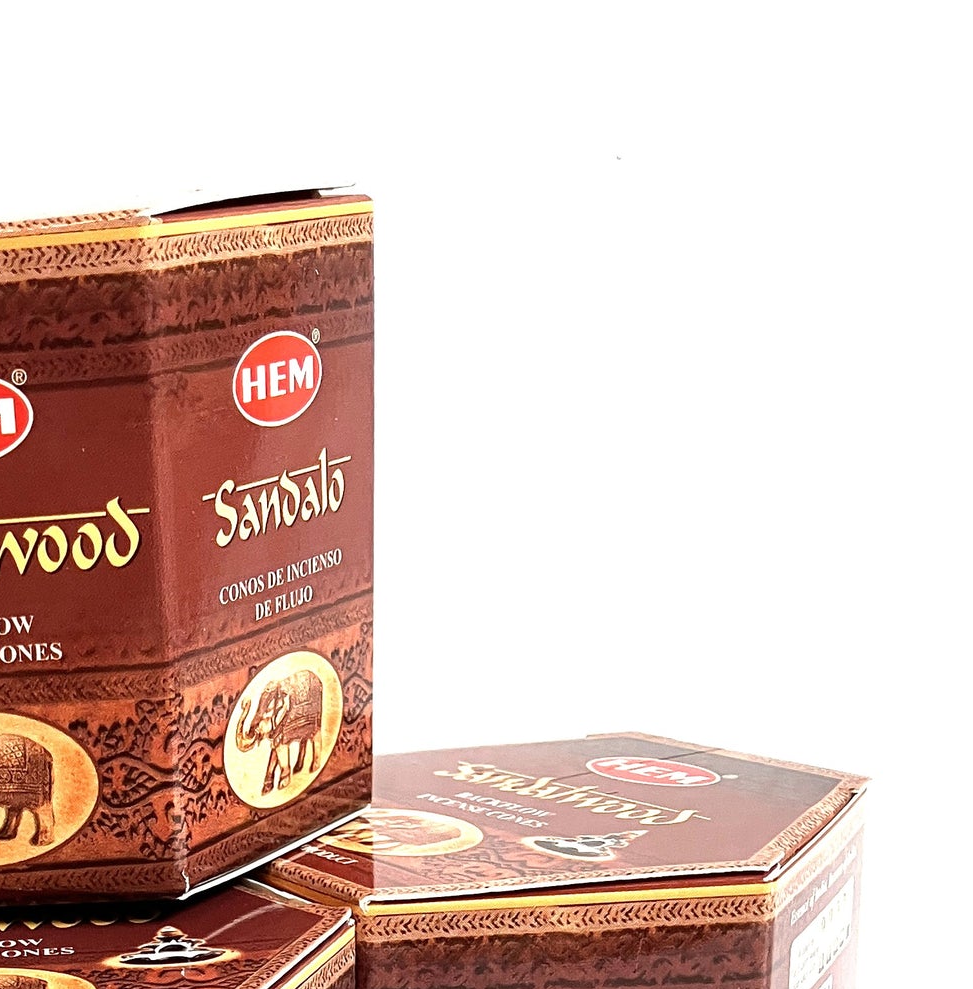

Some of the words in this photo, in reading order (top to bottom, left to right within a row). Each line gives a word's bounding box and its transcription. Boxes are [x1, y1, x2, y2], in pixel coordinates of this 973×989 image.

[242, 354, 314, 404] HEM
[213, 447, 346, 547] Sandalo
[219, 574, 265, 605] CONOS
[267, 569, 284, 591] DE
[286, 548, 342, 583] INCIENSO
[254, 602, 273, 621] DE
[275, 585, 313, 614] FLUJO
[597, 758, 711, 785] HEM
